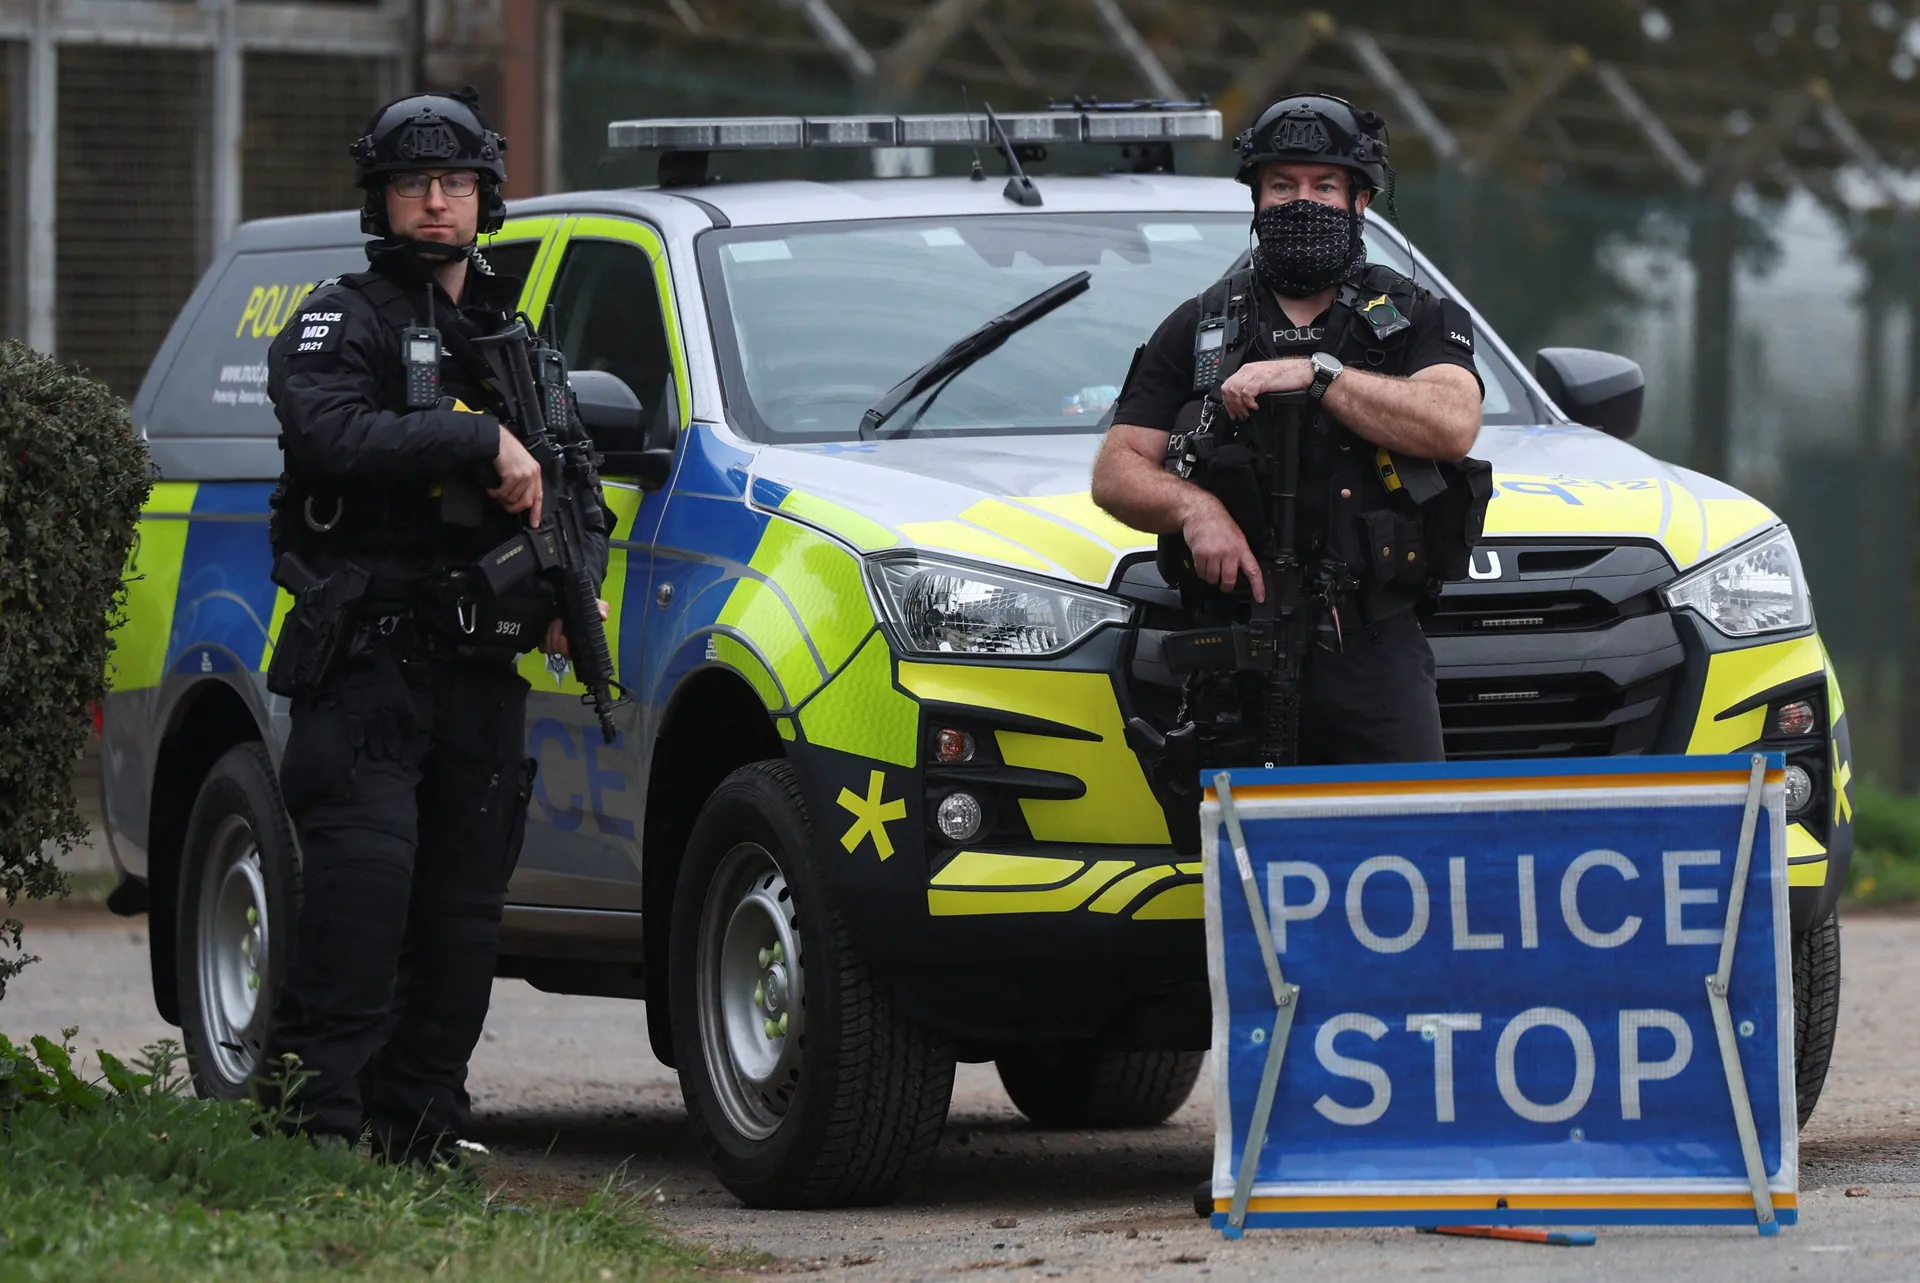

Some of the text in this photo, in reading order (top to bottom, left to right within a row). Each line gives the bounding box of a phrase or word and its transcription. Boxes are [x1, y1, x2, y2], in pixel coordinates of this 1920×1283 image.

[301, 312, 343, 322] POLICE
[301, 325, 330, 339] MD
[1272, 327, 1325, 342] POLIC
[297, 341, 323, 351] 3921
[495, 621, 521, 636] 3921
[1266, 849, 1724, 954] POLICE
[1312, 1006, 1694, 1126] STOP
